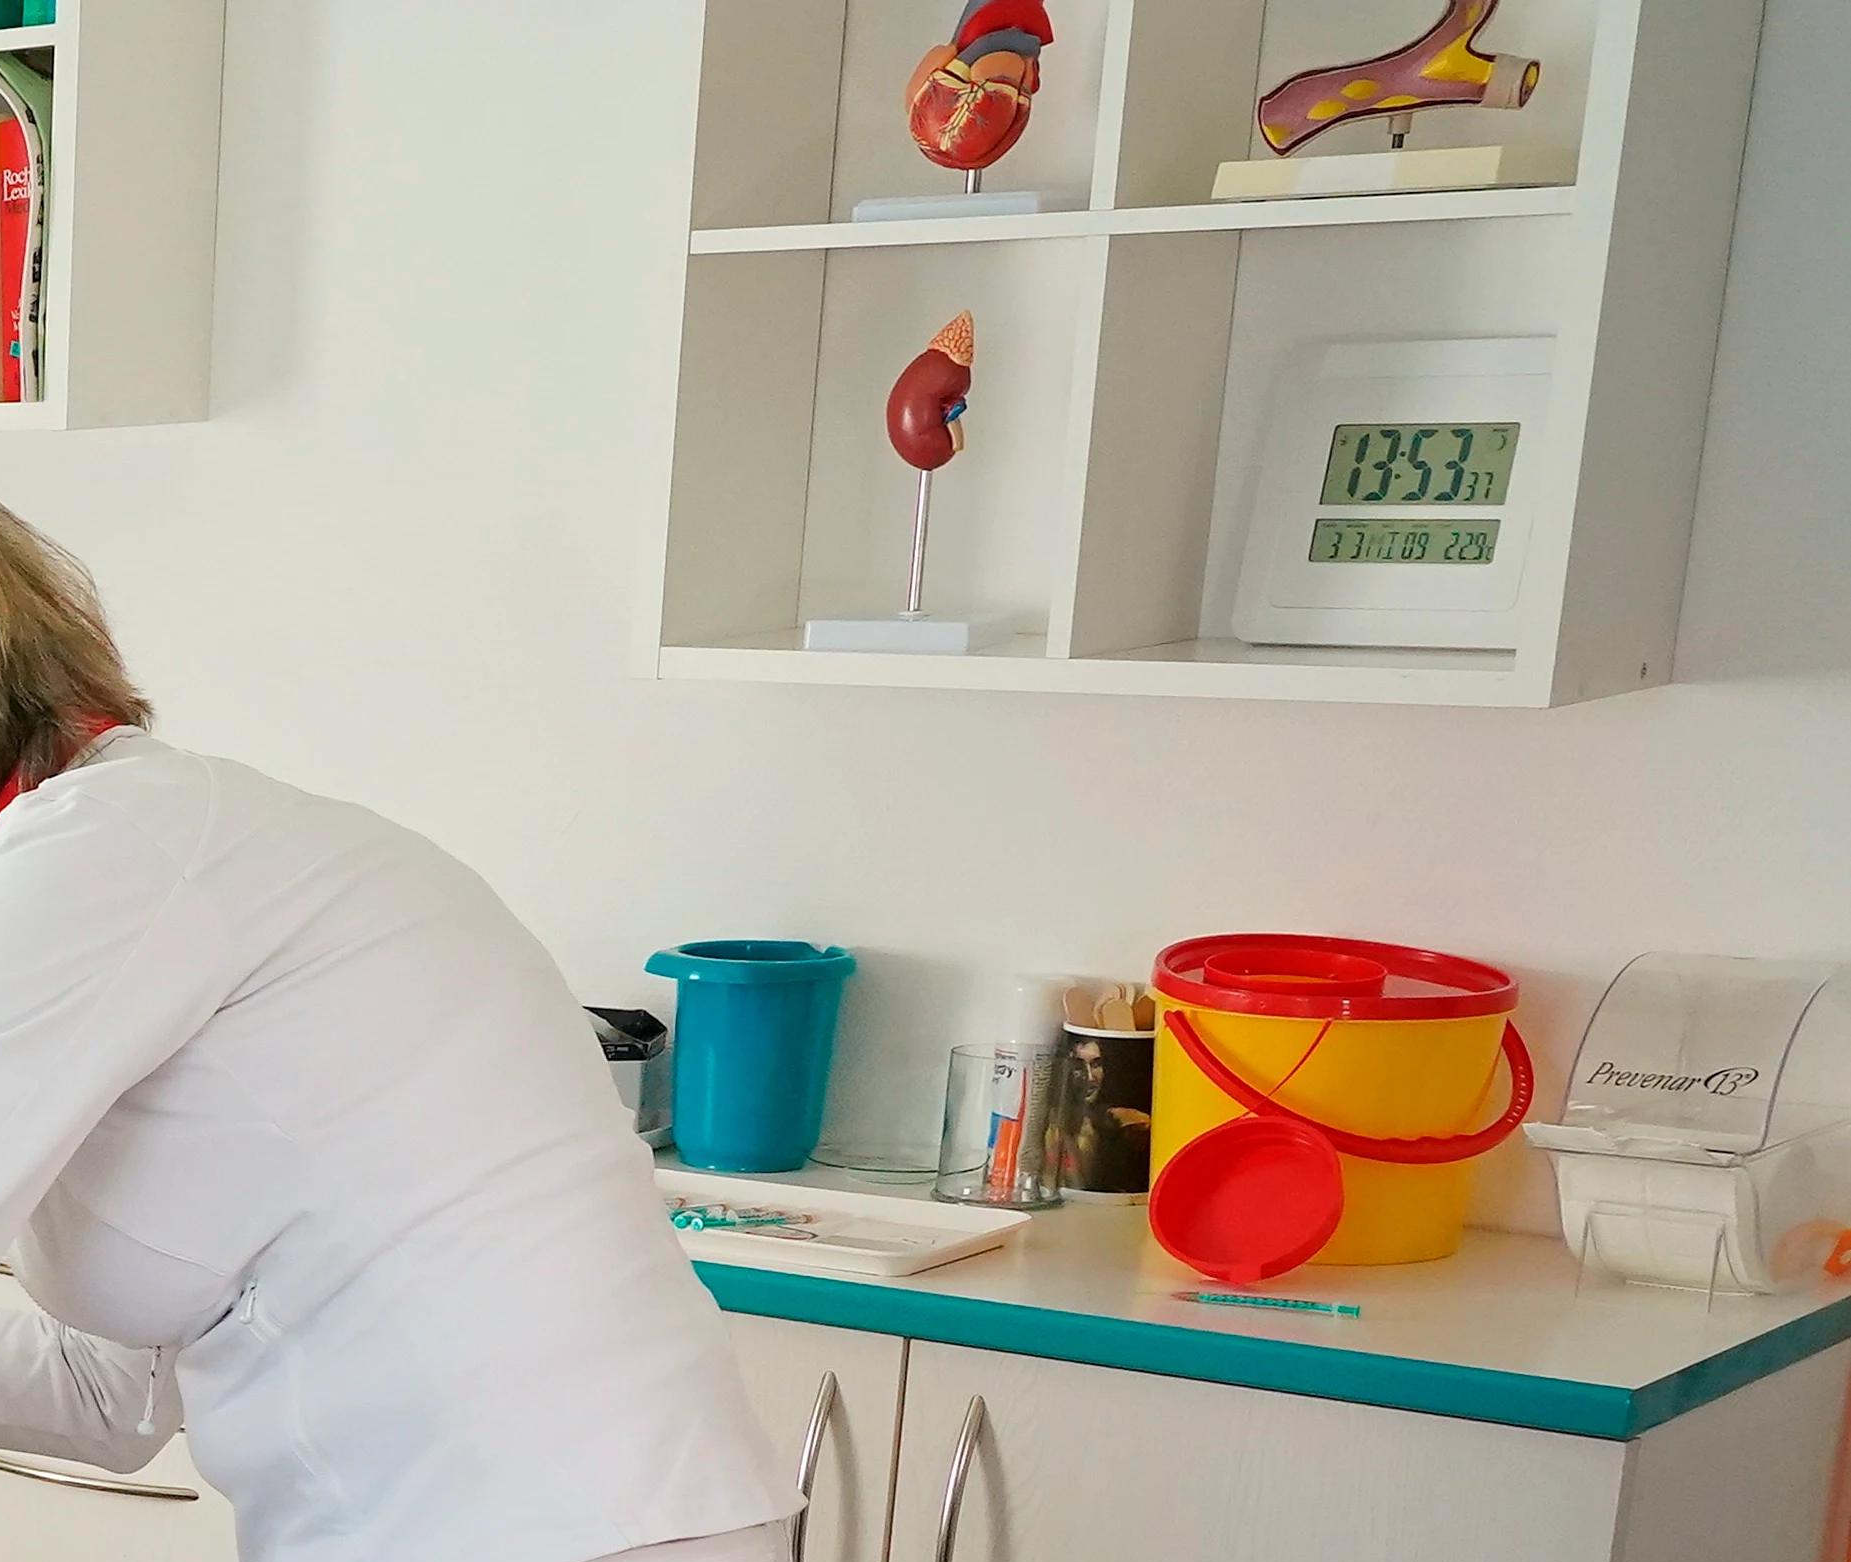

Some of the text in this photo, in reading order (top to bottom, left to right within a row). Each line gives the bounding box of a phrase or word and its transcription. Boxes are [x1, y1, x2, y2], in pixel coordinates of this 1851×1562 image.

[1347, 428, 1494, 502] 13:53 37
[1586, 1061, 1703, 1093] Prevenar
